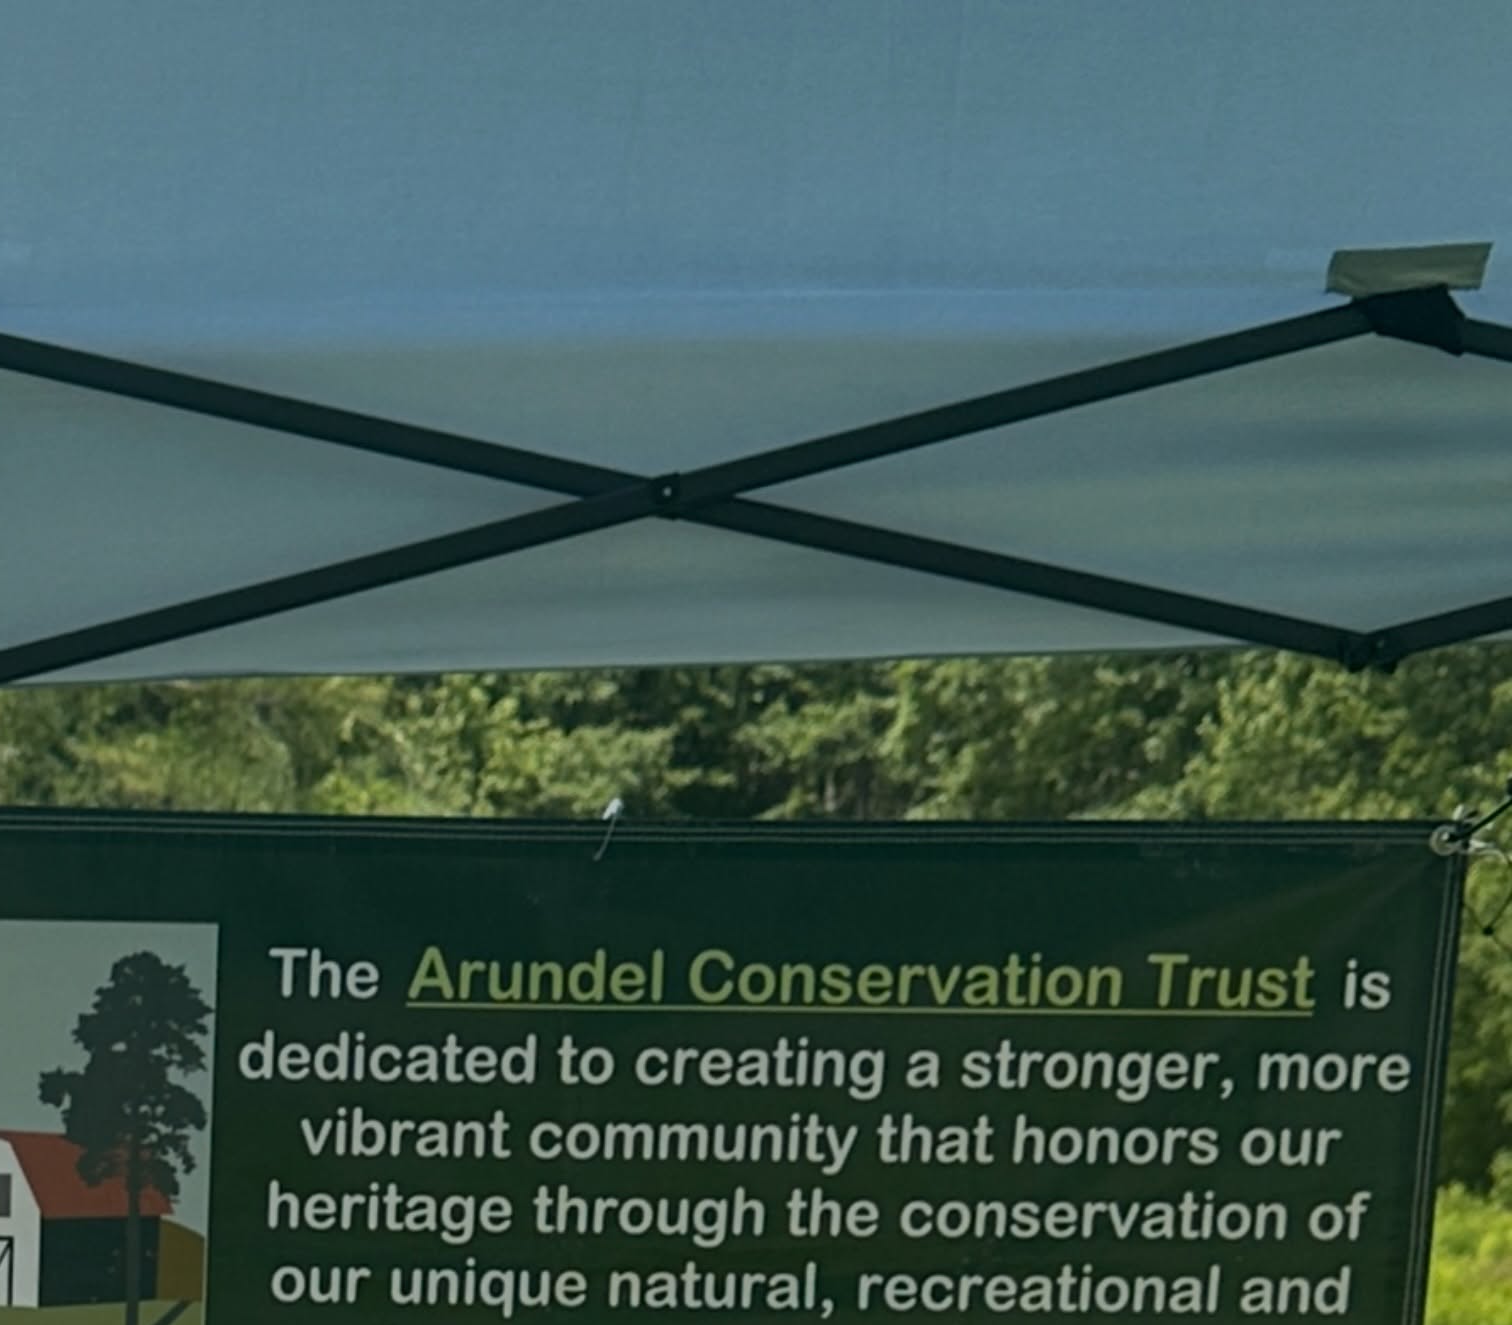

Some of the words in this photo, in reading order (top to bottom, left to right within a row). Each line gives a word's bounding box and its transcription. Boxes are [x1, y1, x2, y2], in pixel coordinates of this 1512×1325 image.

[269, 949, 379, 1000] The
[409, 947, 665, 1004] Arundel
[689, 952, 1122, 1007] Conservation
[1147, 956, 1314, 1010] Trust
[1344, 962, 1390, 1010] is
[239, 1032, 536, 1084] dedicated
[559, 1039, 614, 1085] to
[635, 1041, 884, 1099] creating
[907, 1052, 939, 1089] a
[961, 1045, 1234, 1103] stronger,
[1258, 1056, 1410, 1093] more
[300, 1108, 509, 1160] vibrant
[530, 1114, 858, 1175] community
[878, 1116, 993, 1164] that
[1013, 1119, 1219, 1167] honors
[1240, 1130, 1341, 1168] our
[267, 1182, 511, 1245] heritage
[534, 1187, 764, 1247] through
[787, 1190, 879, 1239] the
[900, 1192, 1287, 1242] conservation
[1309, 1192, 1372, 1242] of
[270, 1266, 370, 1306] our
[391, 1259, 586, 1321] unique
[609, 1261, 834, 1318] natural,
[858, 1265, 1220, 1314] recreational
[1241, 1267, 1350, 1316] and
